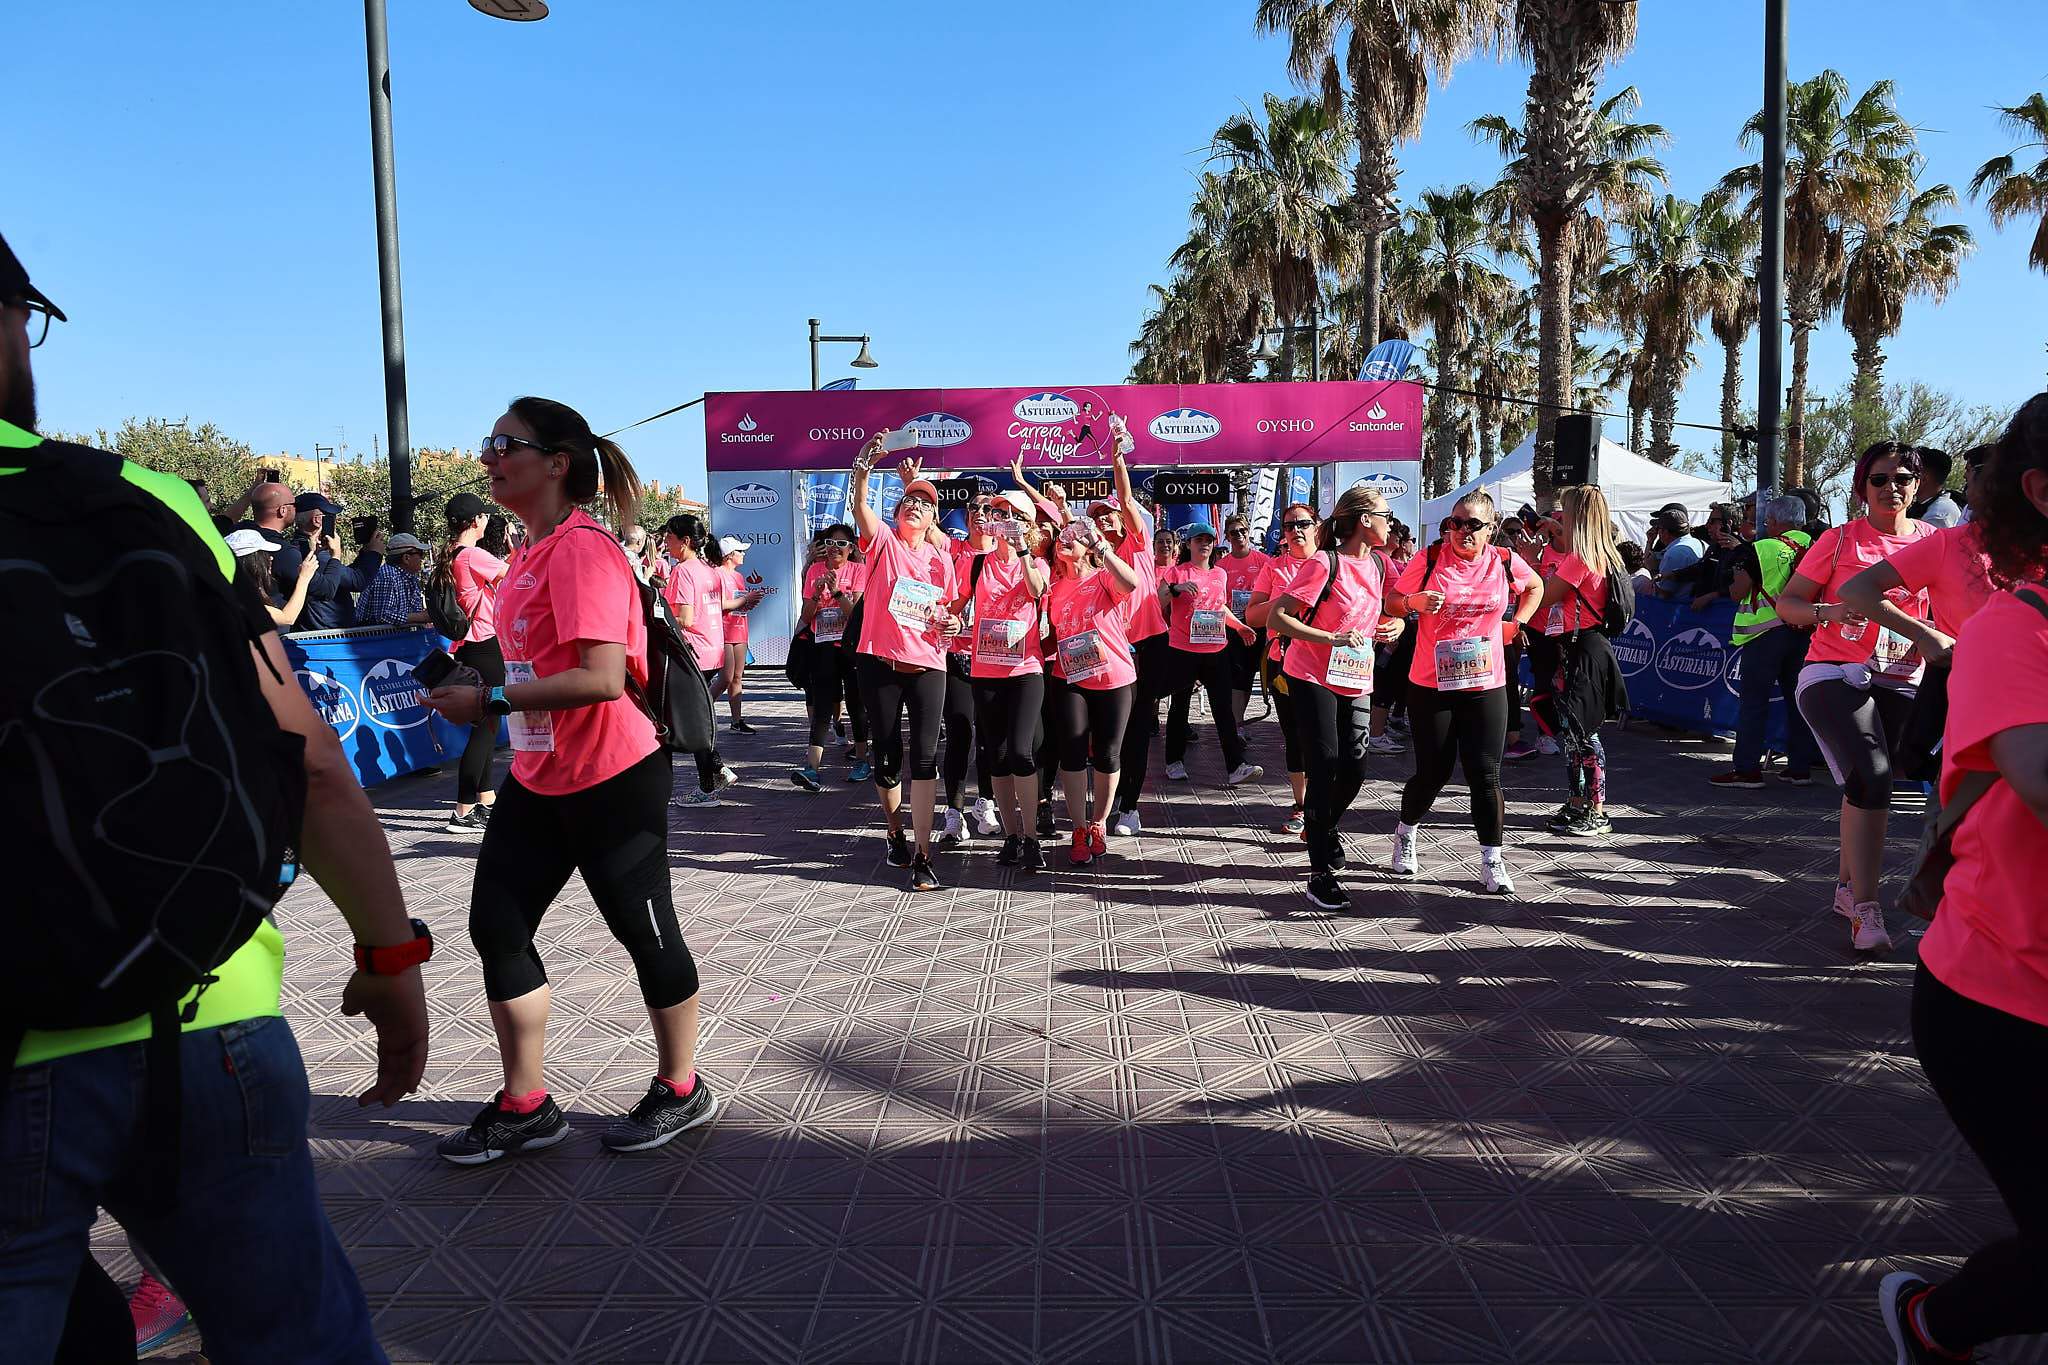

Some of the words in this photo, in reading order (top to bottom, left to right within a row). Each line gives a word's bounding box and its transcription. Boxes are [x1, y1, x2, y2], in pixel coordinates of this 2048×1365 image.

[1020, 404, 1075, 416] ASTURIANA
[909, 426, 967, 439] STURIANA
[1007, 421, 1063, 438] Carrera
[1154, 421, 1216, 435] ASTURIANA
[1256, 418, 1314, 433] OYSHO
[1349, 421, 1405, 432] Santander
[721, 432, 775, 443] Santander
[809, 427, 865, 441] OYSHO
[1020, 438, 1032, 450] de
[1033, 438, 1041, 450] la
[1039, 435, 1083, 463] Mujer
[938, 488, 969, 501] SHO
[1165, 482, 1220, 496] OYSHO
[728, 493, 776, 504] ASTURIANA
[722, 532, 783, 546] YSHO
[1610, 644, 1649, 665] STURIANA
[1658, 646, 1719, 677] ASTURIANA
